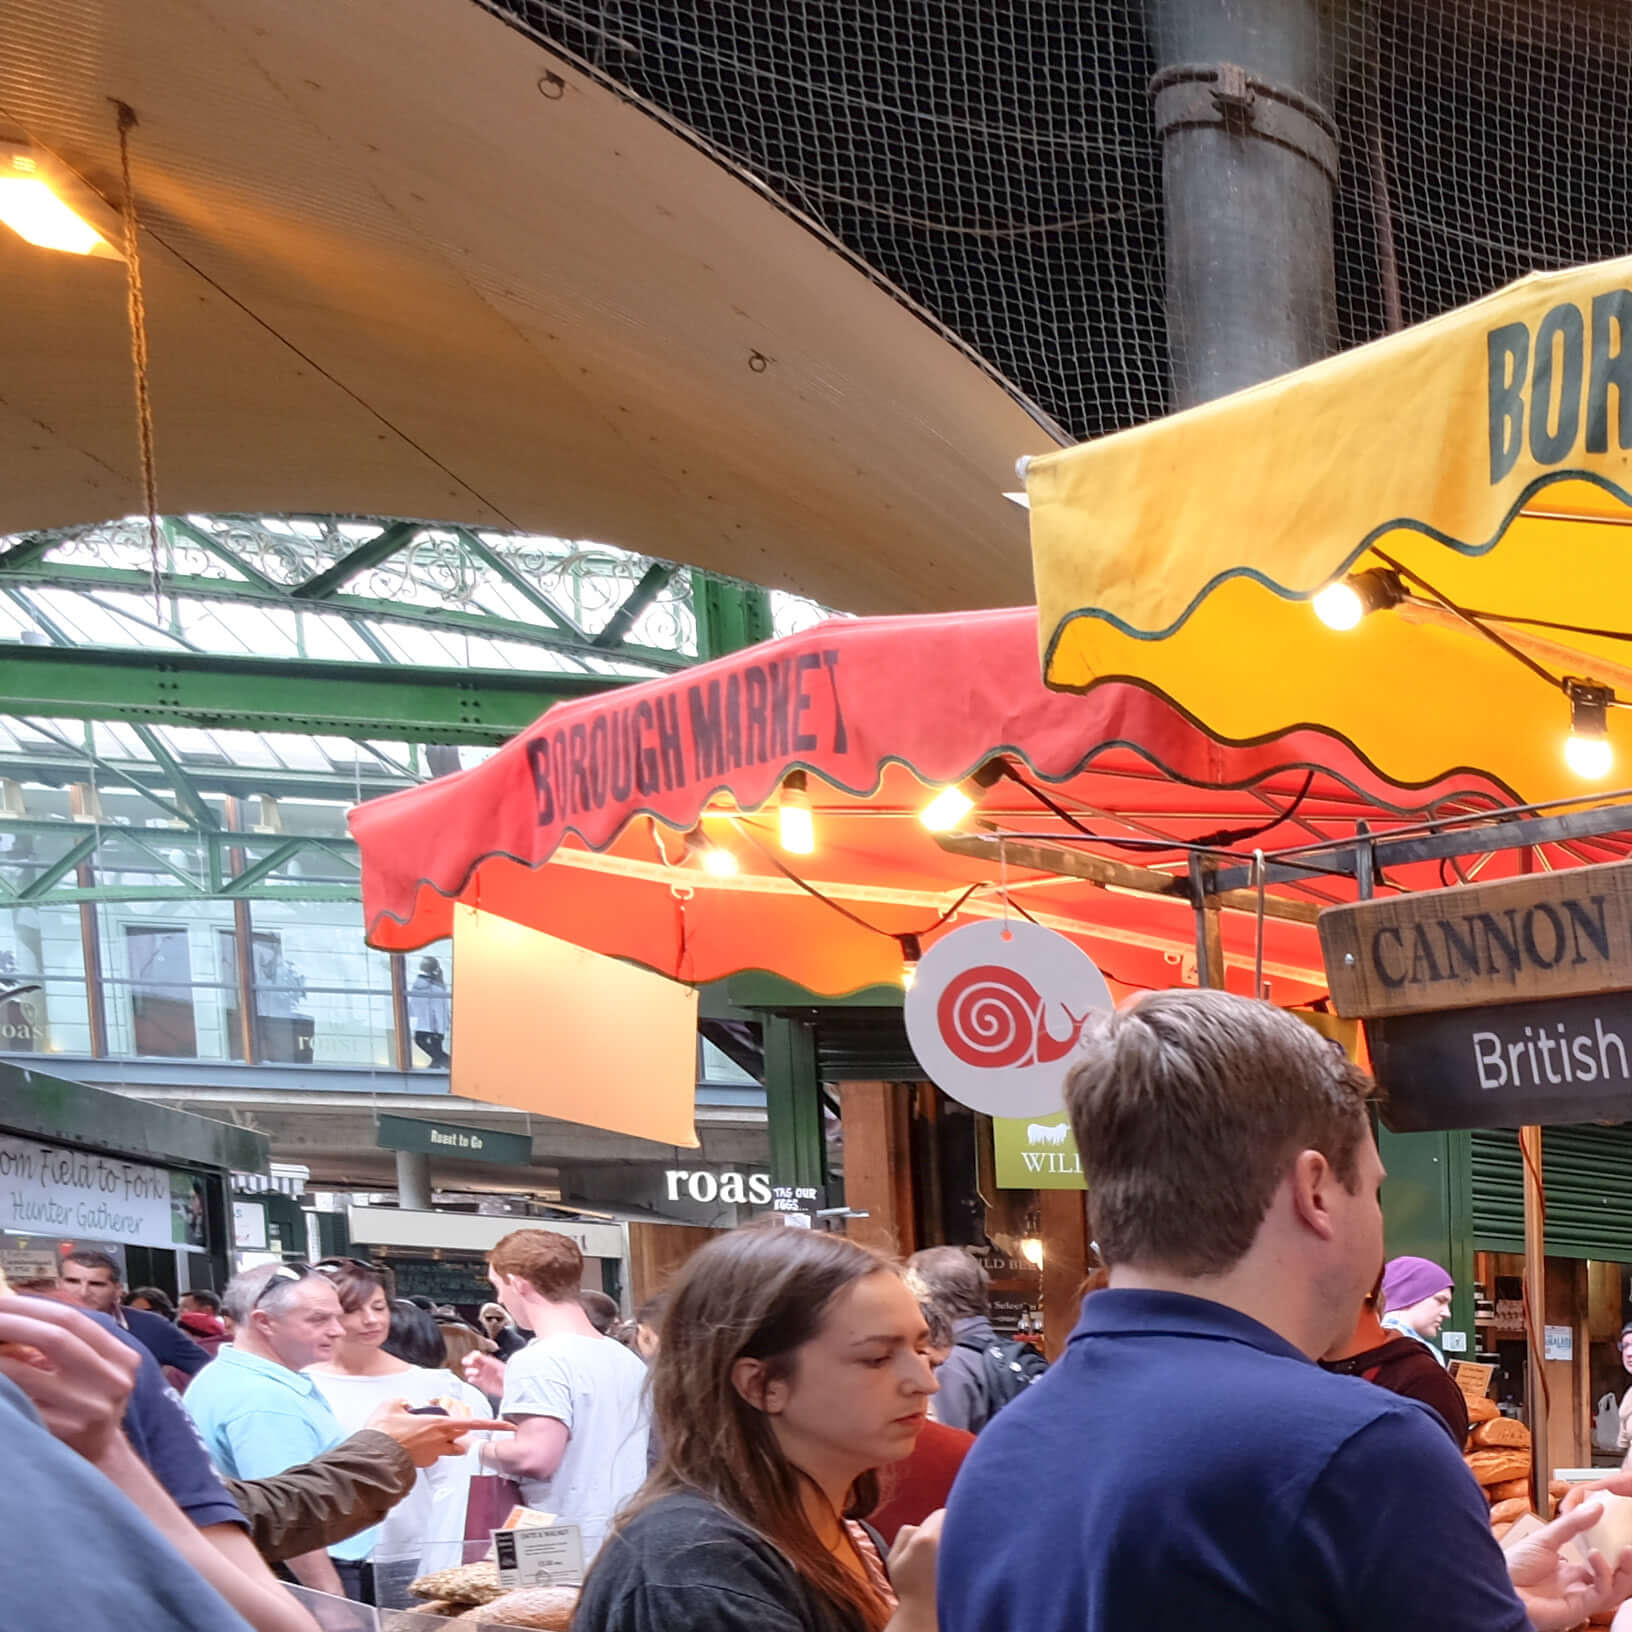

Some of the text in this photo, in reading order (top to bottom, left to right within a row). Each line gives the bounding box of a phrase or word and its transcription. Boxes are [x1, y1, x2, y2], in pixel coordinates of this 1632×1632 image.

[526, 650, 848, 826] BOROUGH MARKET
[1372, 893, 1609, 992] CANNON
[1472, 1017, 1630, 1091] British
[431, 1129, 484, 1149] Roast to Go
[0, 1149, 165, 1201] om Field to Fork
[665, 1170, 772, 1204] roas
[10, 1191, 144, 1234] Hunter Gatherer
